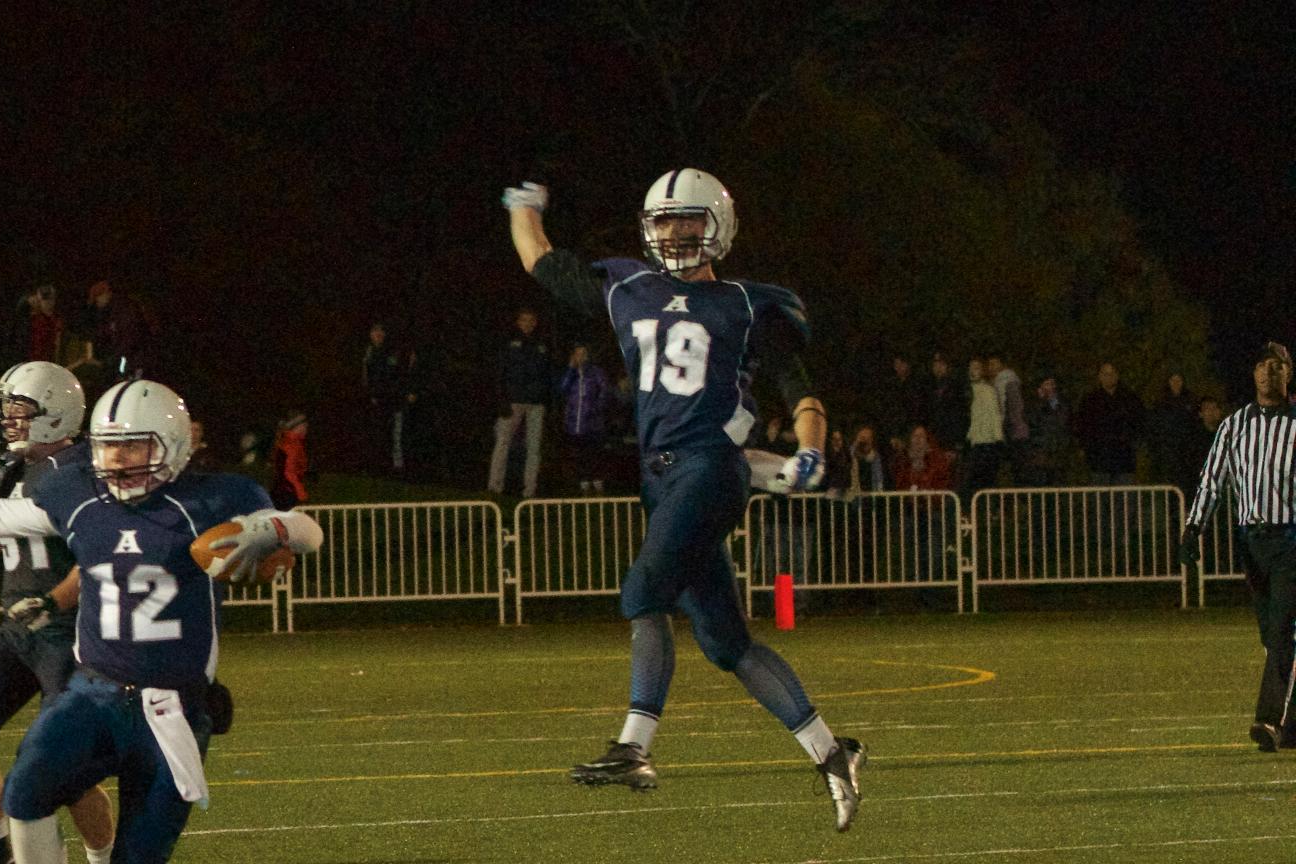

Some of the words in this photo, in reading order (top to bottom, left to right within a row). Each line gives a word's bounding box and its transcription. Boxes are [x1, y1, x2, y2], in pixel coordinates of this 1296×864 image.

[662, 295, 690, 312] A
[631, 319, 711, 396] 19
[112, 529, 143, 554] A
[86, 562, 182, 641] 12
